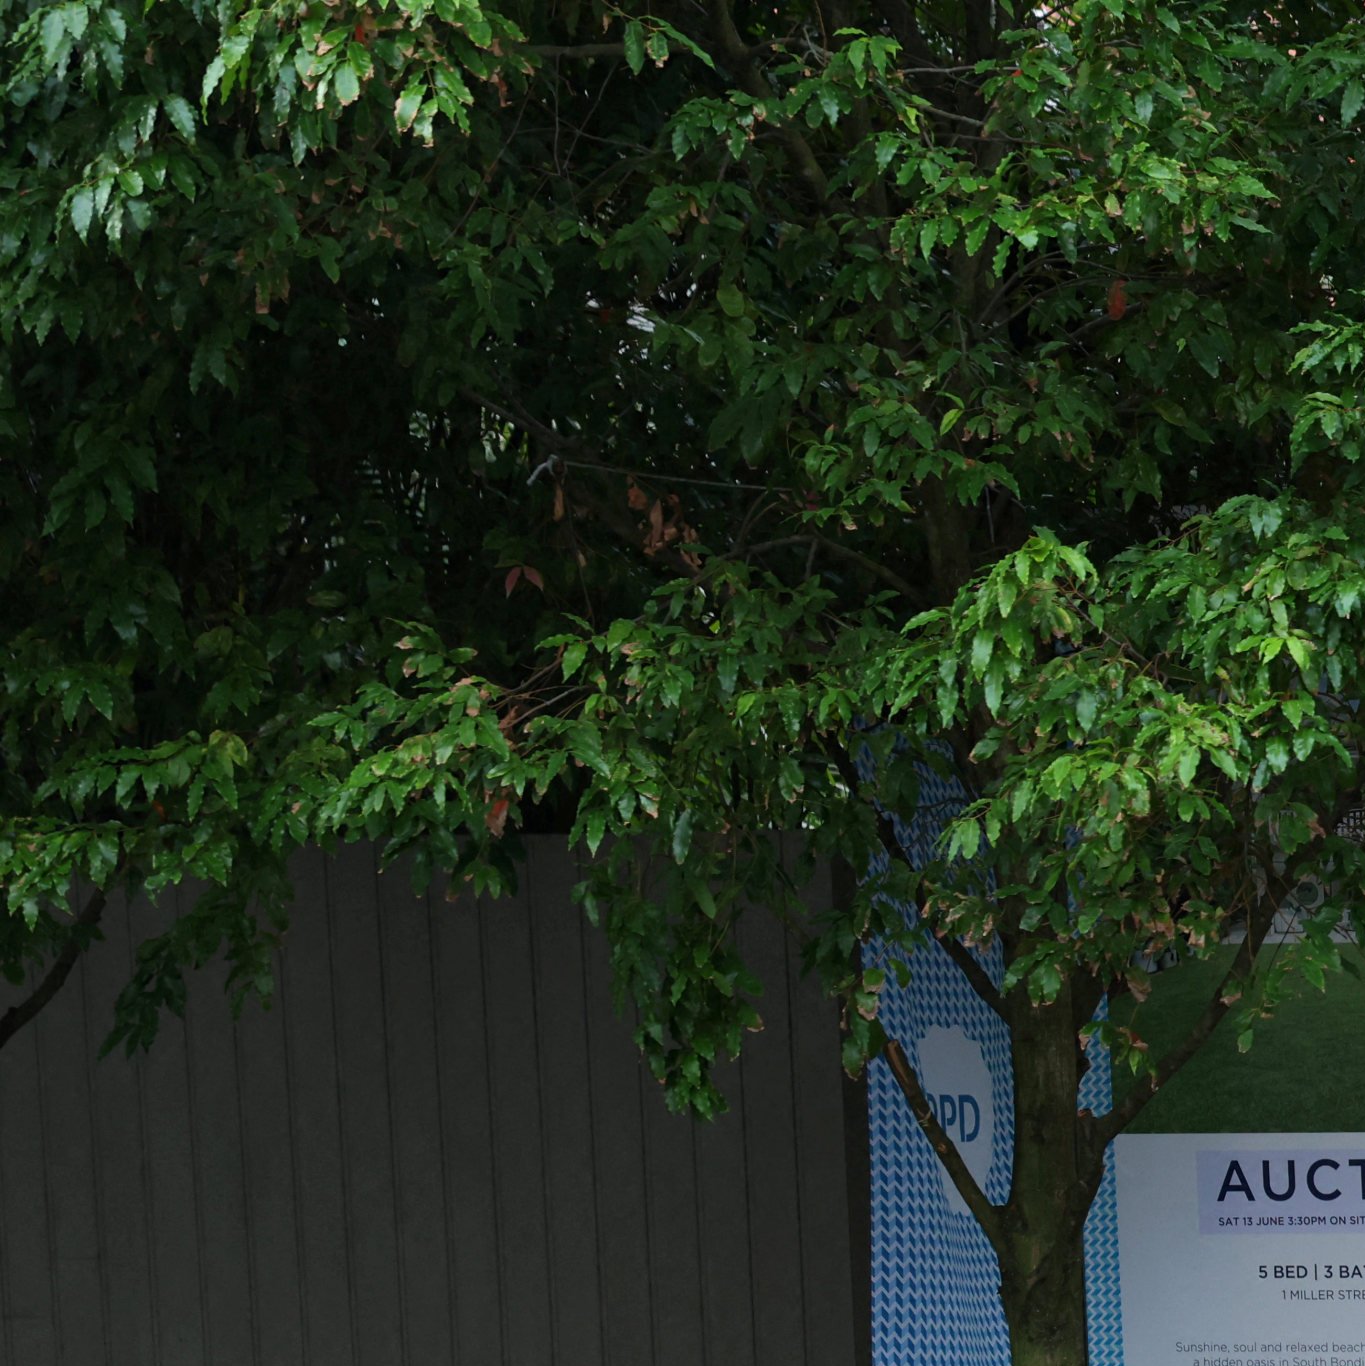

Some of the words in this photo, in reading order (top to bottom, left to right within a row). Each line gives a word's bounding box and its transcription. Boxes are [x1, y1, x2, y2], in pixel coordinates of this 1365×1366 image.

[1219, 1217, 1239, 1226] SAT
[1243, 1217, 1253, 1226] 13
[1256, 1217, 1284, 1226] JUNE
[1288, 1216, 1326, 1226] 3:30PM
[1330, 1216, 1346, 1225] ON
[1259, 1265, 1267, 1279] 5
[1274, 1265, 1308, 1278] BED
[1324, 1265, 1333, 1278] 3
[1282, 1290, 1286, 1300] 1
[1290, 1290, 1334, 1300] MILLER
[1233, 1342, 1257, 1352] soul
[1261, 1342, 1282, 1353] and
[1286, 1342, 1328, 1353] relaxed
[1193, 1359, 1200, 1366] a
